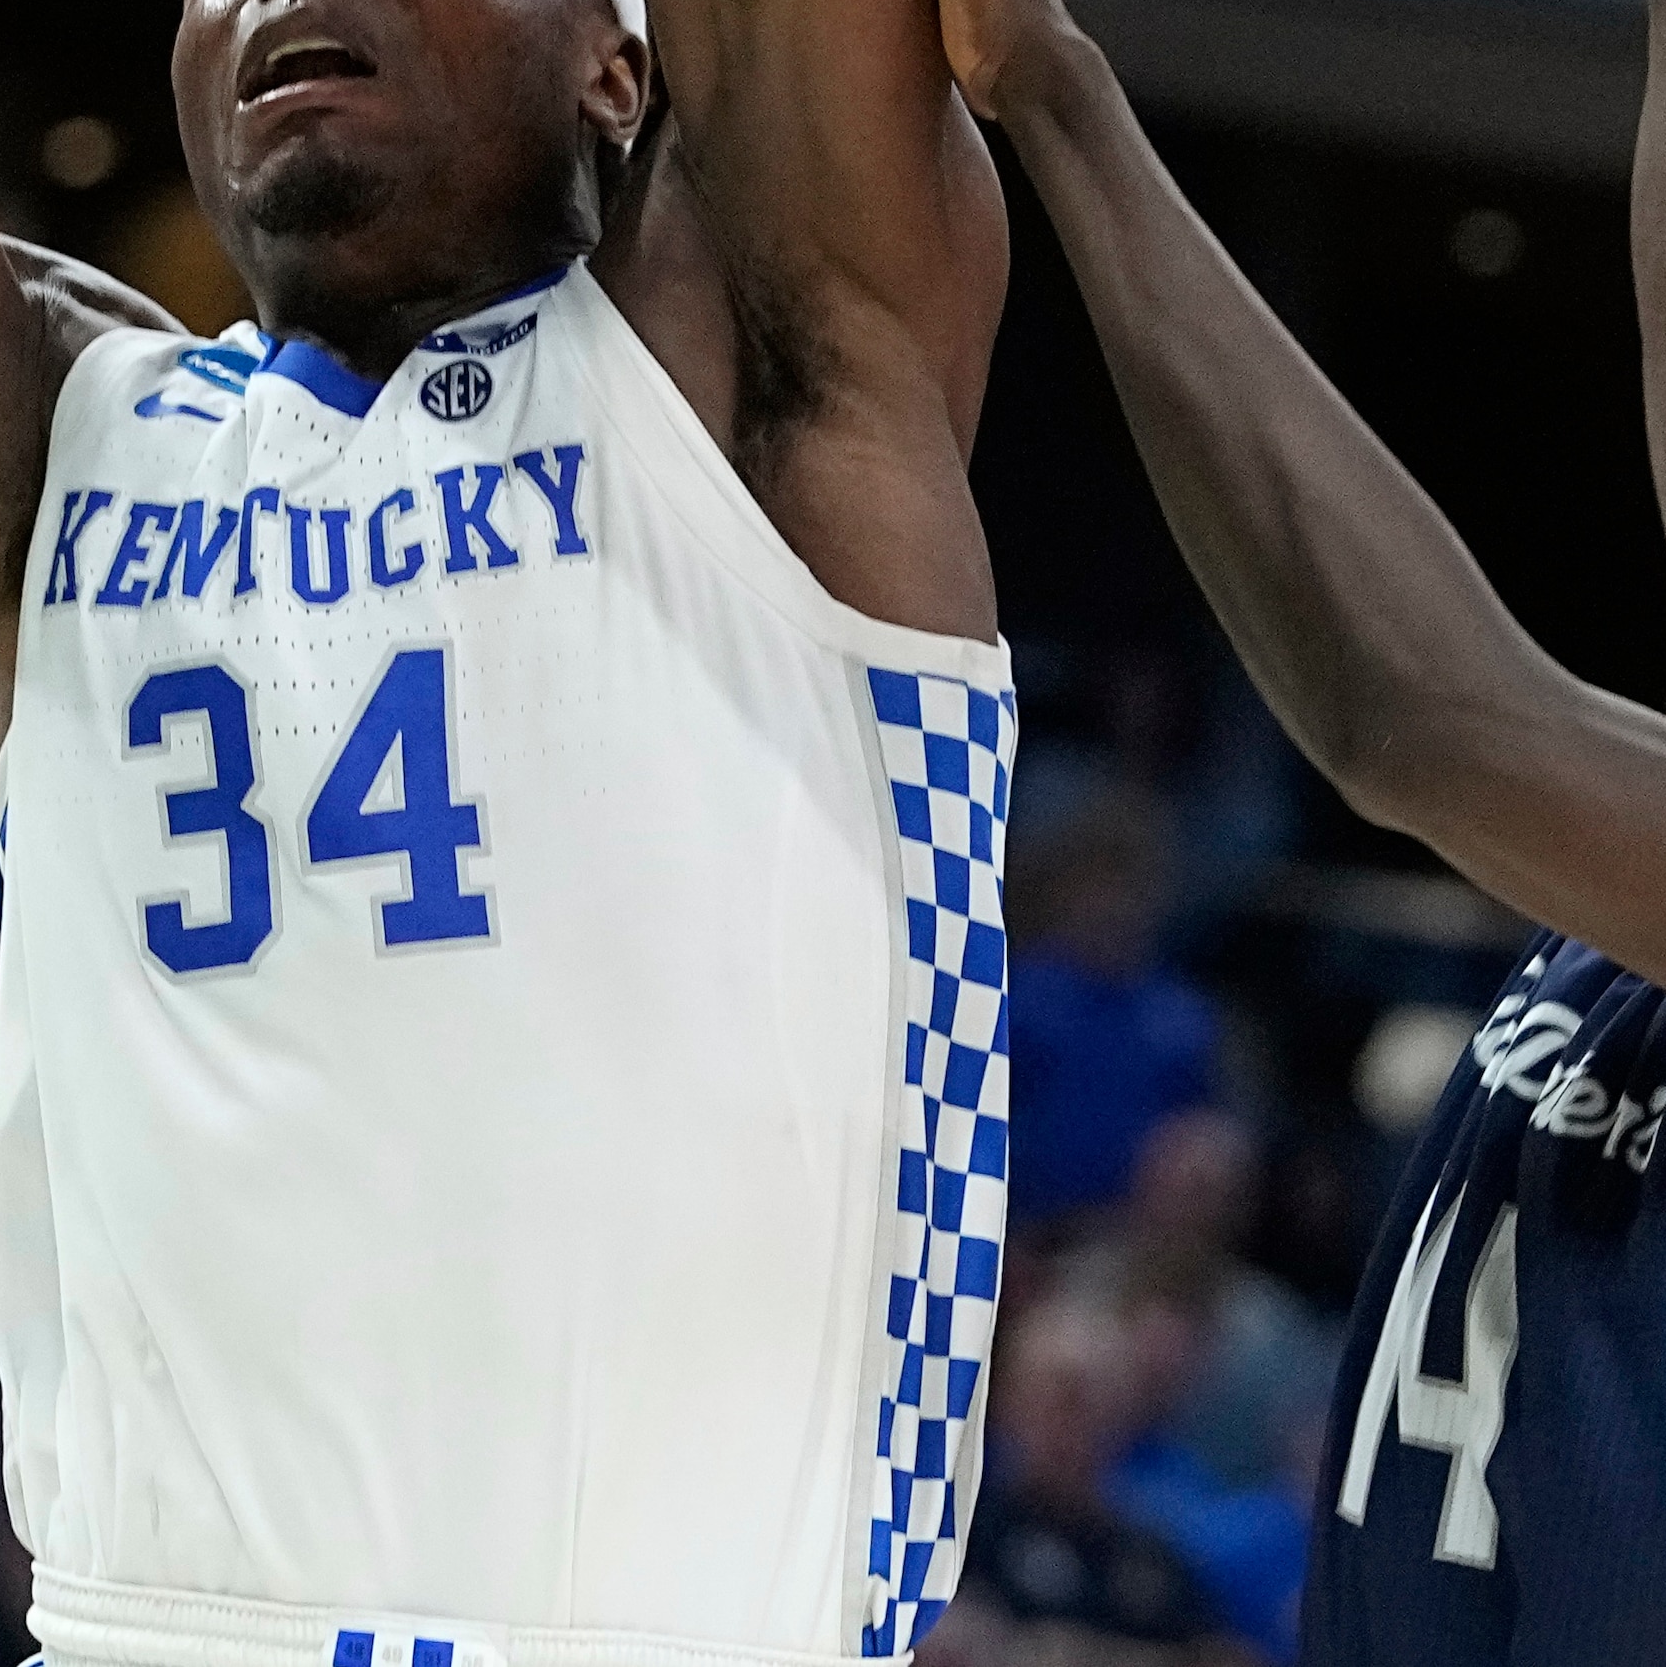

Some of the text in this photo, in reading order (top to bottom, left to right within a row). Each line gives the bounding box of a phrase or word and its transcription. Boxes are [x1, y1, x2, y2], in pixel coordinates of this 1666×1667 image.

[425, 362, 489, 418] SEC
[42, 442, 590, 609] KENTUCKY
[121, 637, 501, 985] 34
